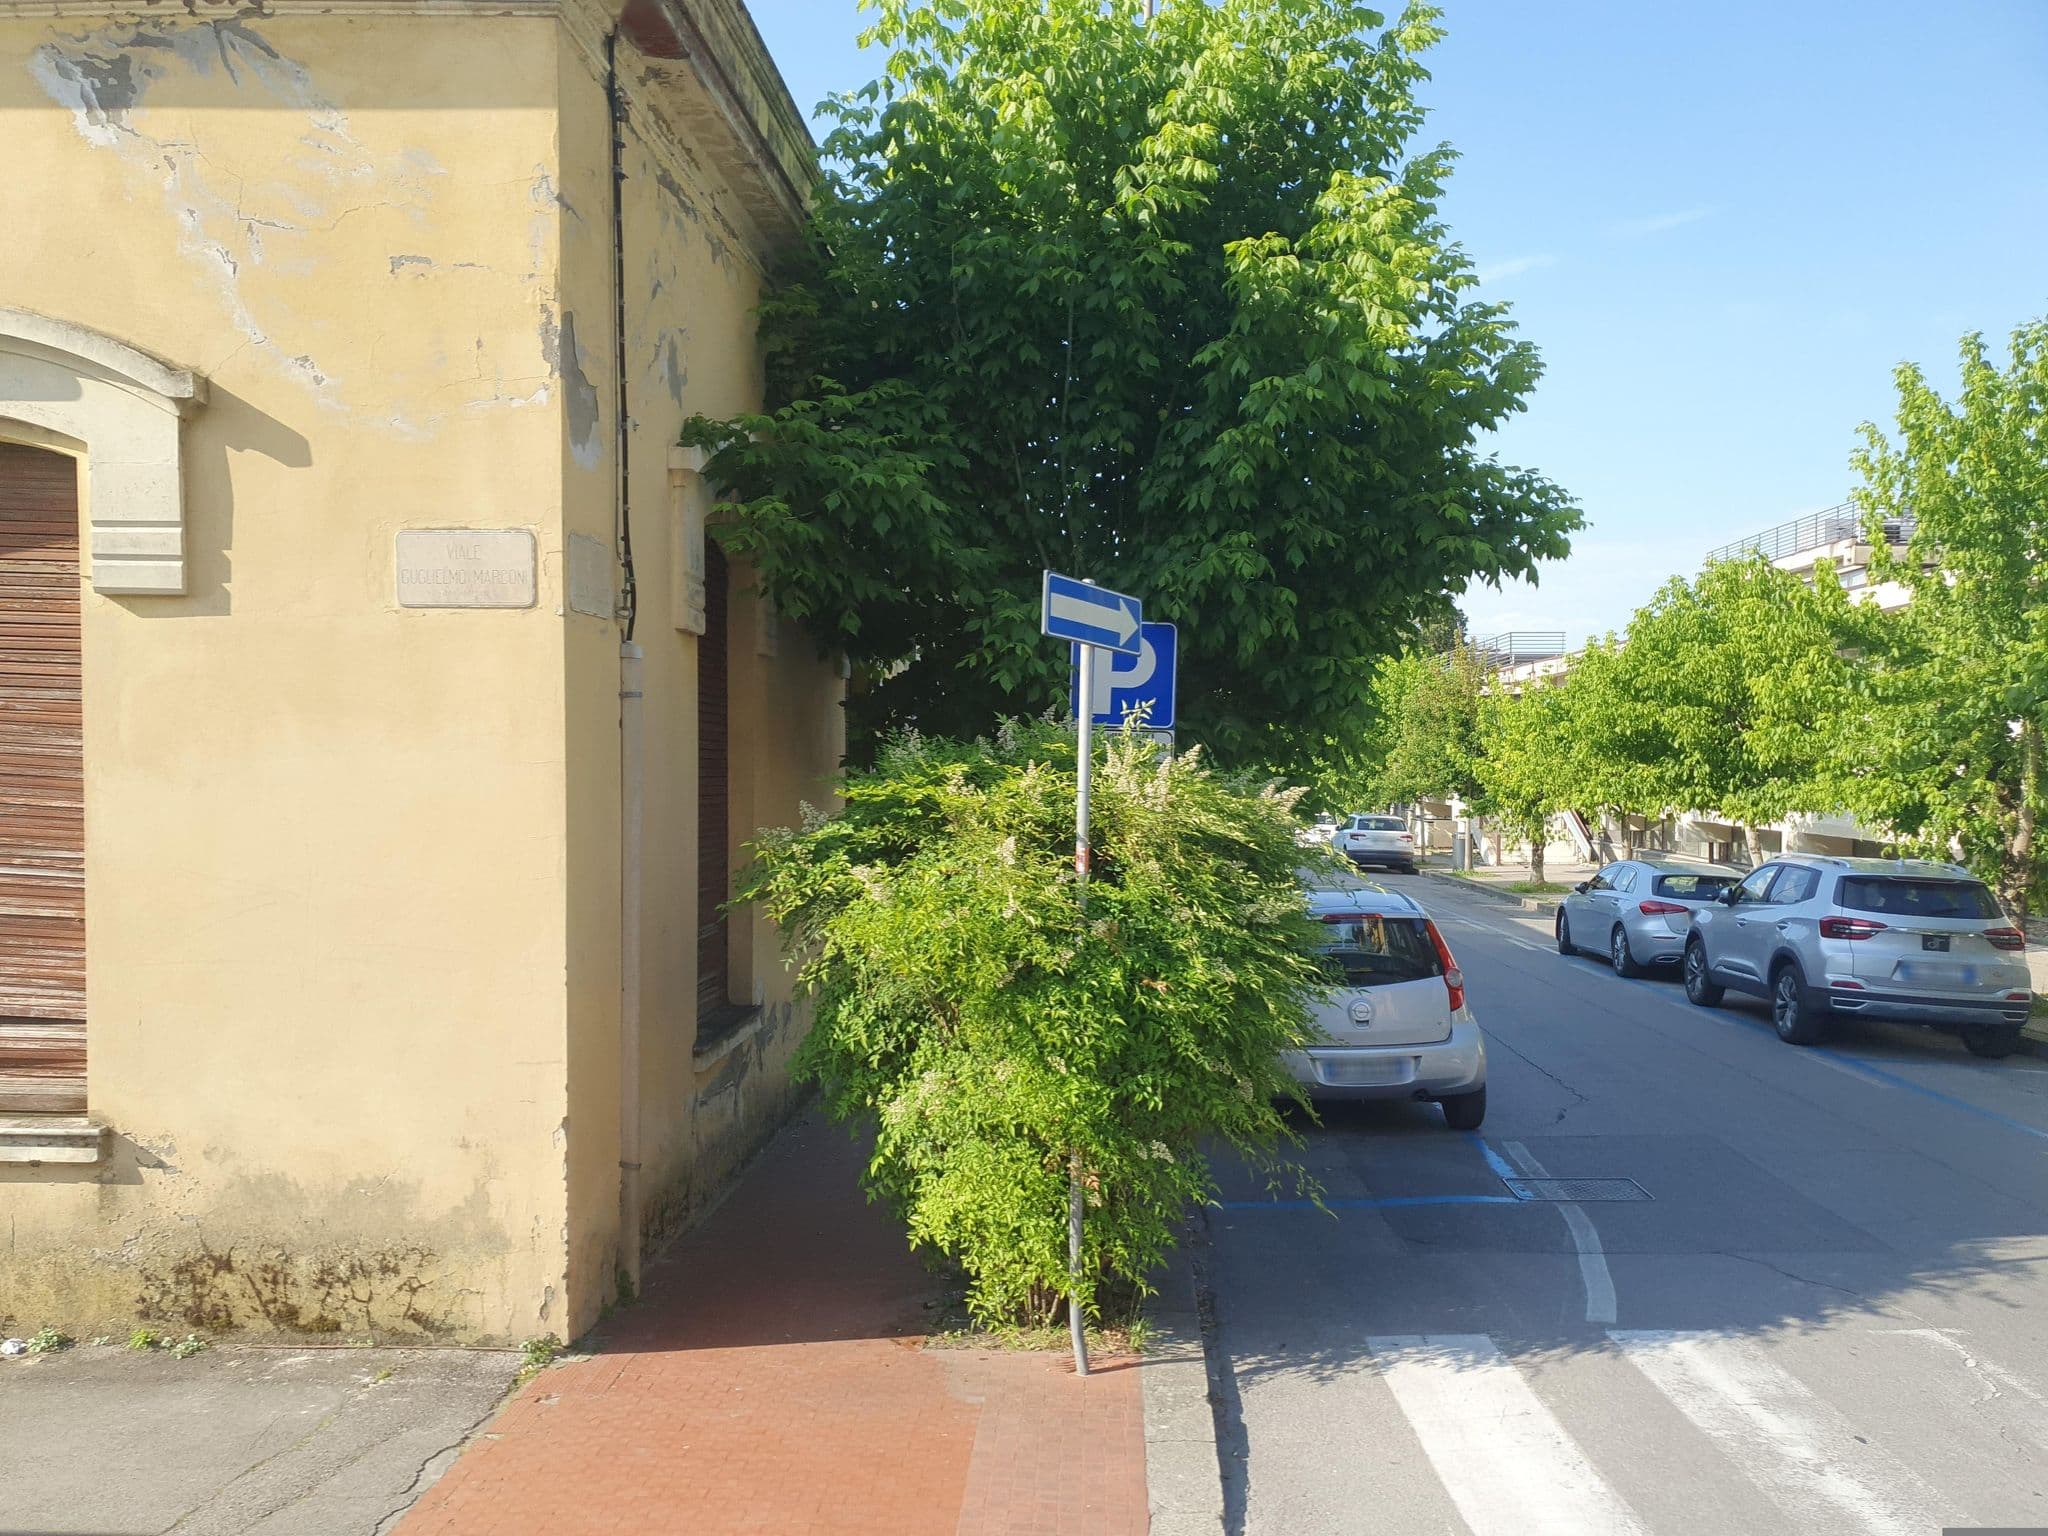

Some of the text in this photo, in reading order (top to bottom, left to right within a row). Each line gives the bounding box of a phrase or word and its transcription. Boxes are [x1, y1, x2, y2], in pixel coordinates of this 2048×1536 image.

[446, 544, 481, 560] VIALE
[401, 568, 528, 585] GUGLIELMO MARCONI
[1092, 636, 1157, 715] P
